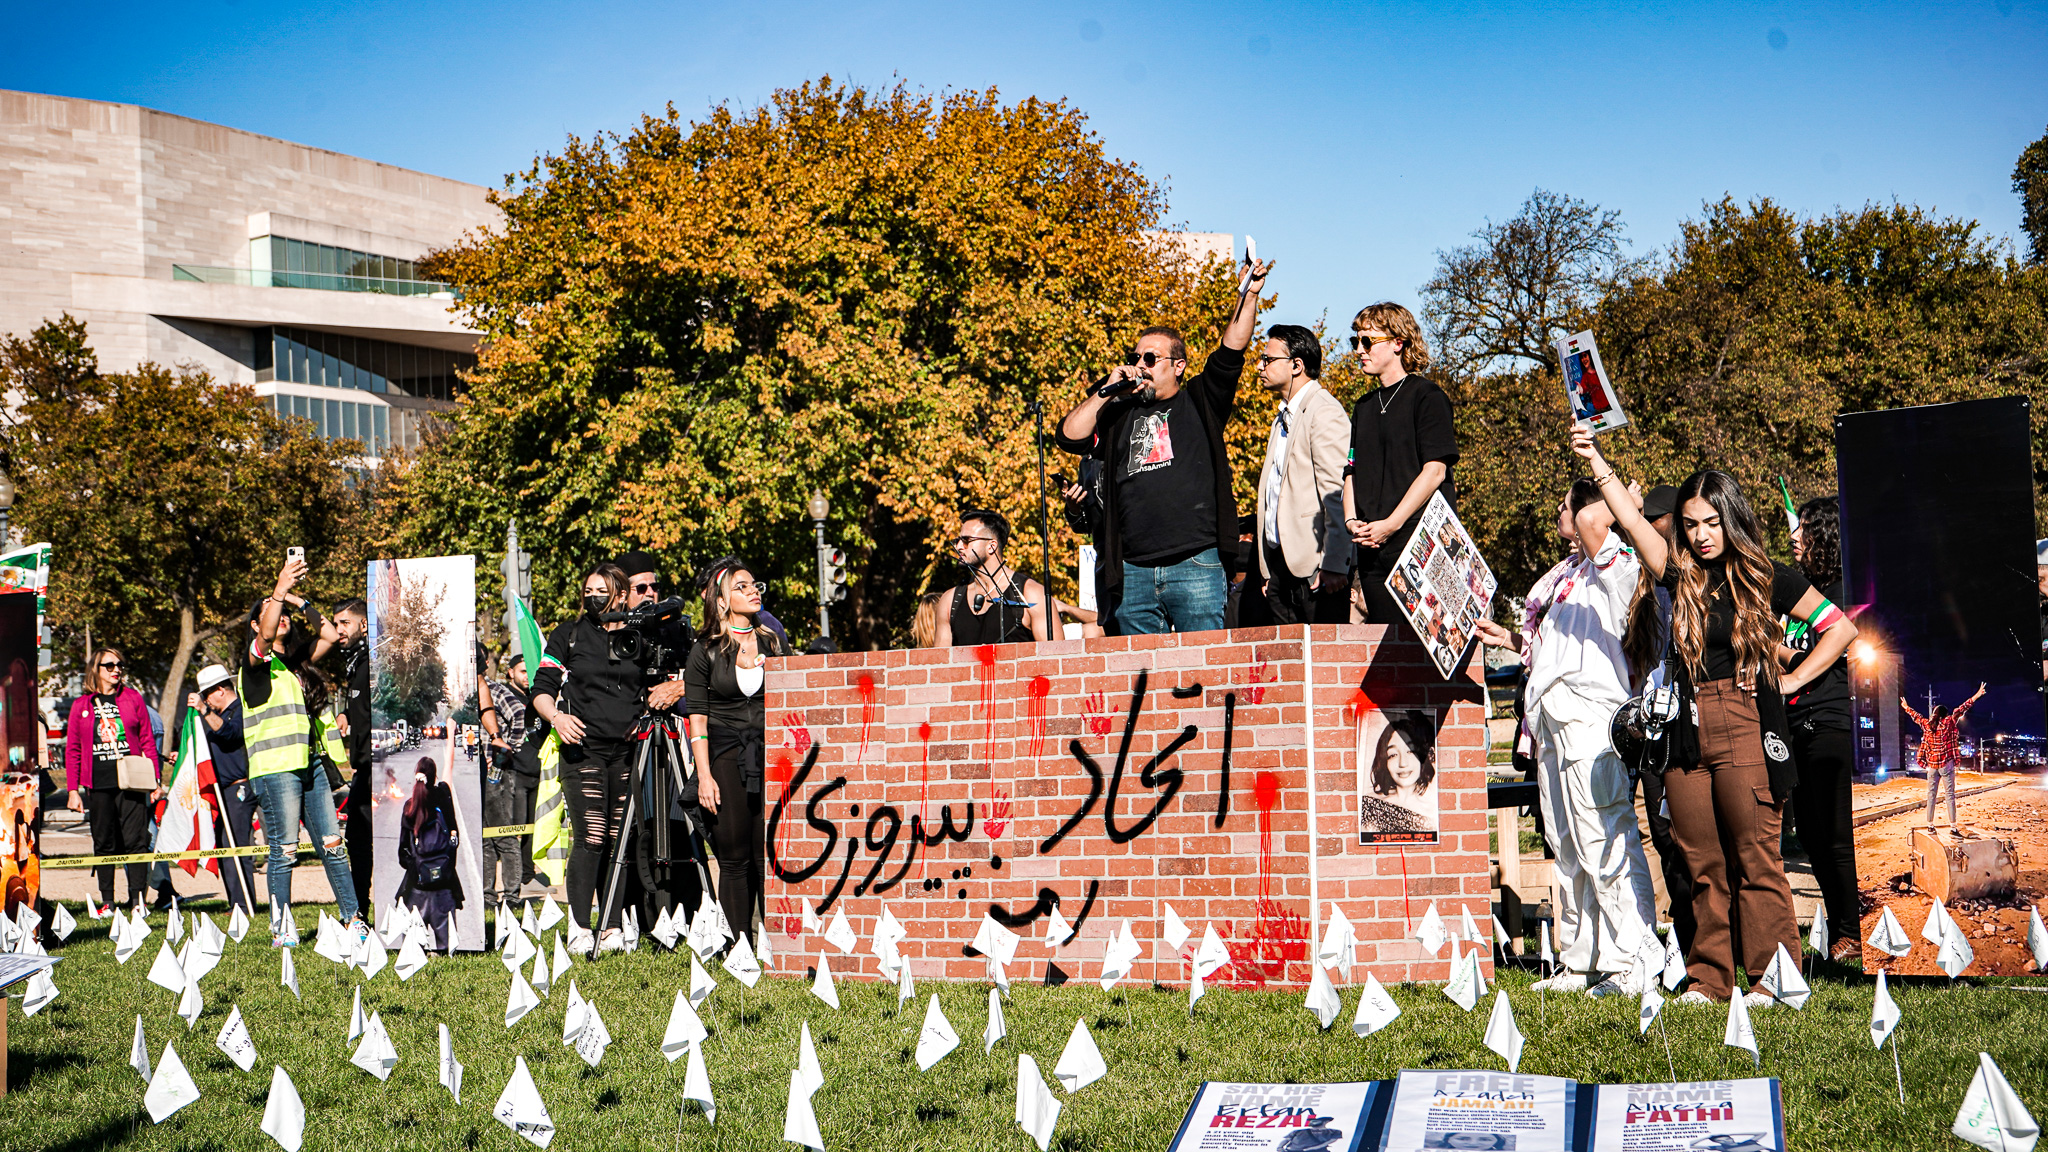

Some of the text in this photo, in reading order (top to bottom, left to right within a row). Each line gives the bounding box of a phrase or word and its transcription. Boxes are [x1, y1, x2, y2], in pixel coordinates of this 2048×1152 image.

[767, 669, 1235, 915] اتحاد پیروزی
[498, 826, 526, 834] CUIDADO
[1435, 1074, 1534, 1093] FREE
[1628, 1080, 1734, 1092] SAY HIS
[1225, 1085, 1327, 1096] SAY HIS
[1434, 1090, 1534, 1102] Azadeh
[1628, 1089, 1732, 1104] NAME
[1220, 1094, 1322, 1108] NAME
[1626, 1102, 1732, 1113] Alireza
[1626, 1108, 1734, 1124] FATHI
